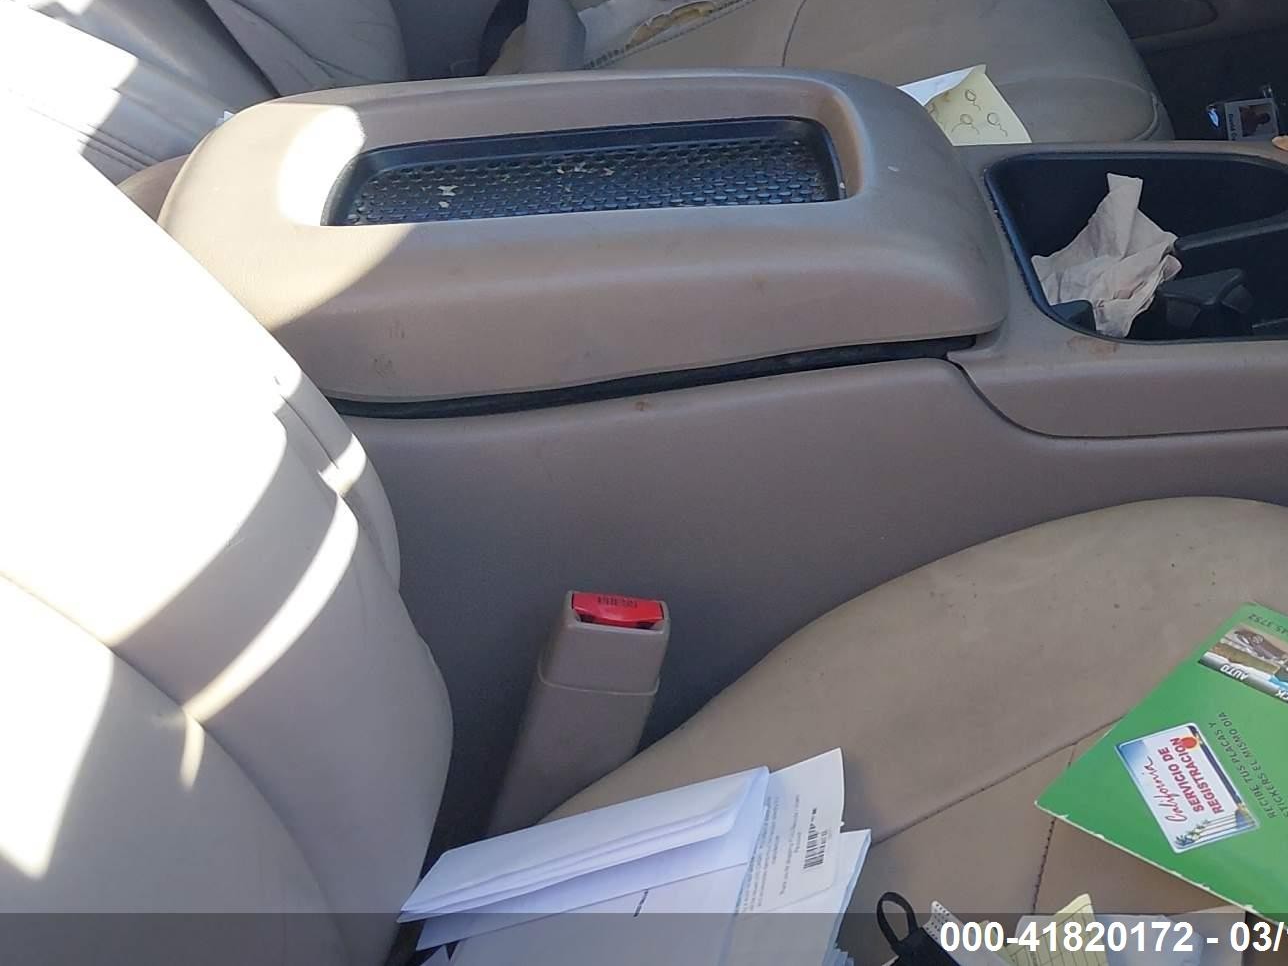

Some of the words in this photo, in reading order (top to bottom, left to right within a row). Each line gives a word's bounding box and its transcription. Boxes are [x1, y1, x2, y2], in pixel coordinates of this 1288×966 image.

[1219, 662, 1249, 682] AUTO
[1158, 747, 1174, 762] DE
[1215, 729, 1240, 763] PLACAS
[1229, 728, 1253, 758] MISMO
[1170, 738, 1224, 814] REGISTRACION
[1238, 765, 1252, 783] TUS
[1250, 760, 1261, 771] EL
[1142, 756, 1188, 822] California
[1168, 764, 1204, 812] SERVICIO
